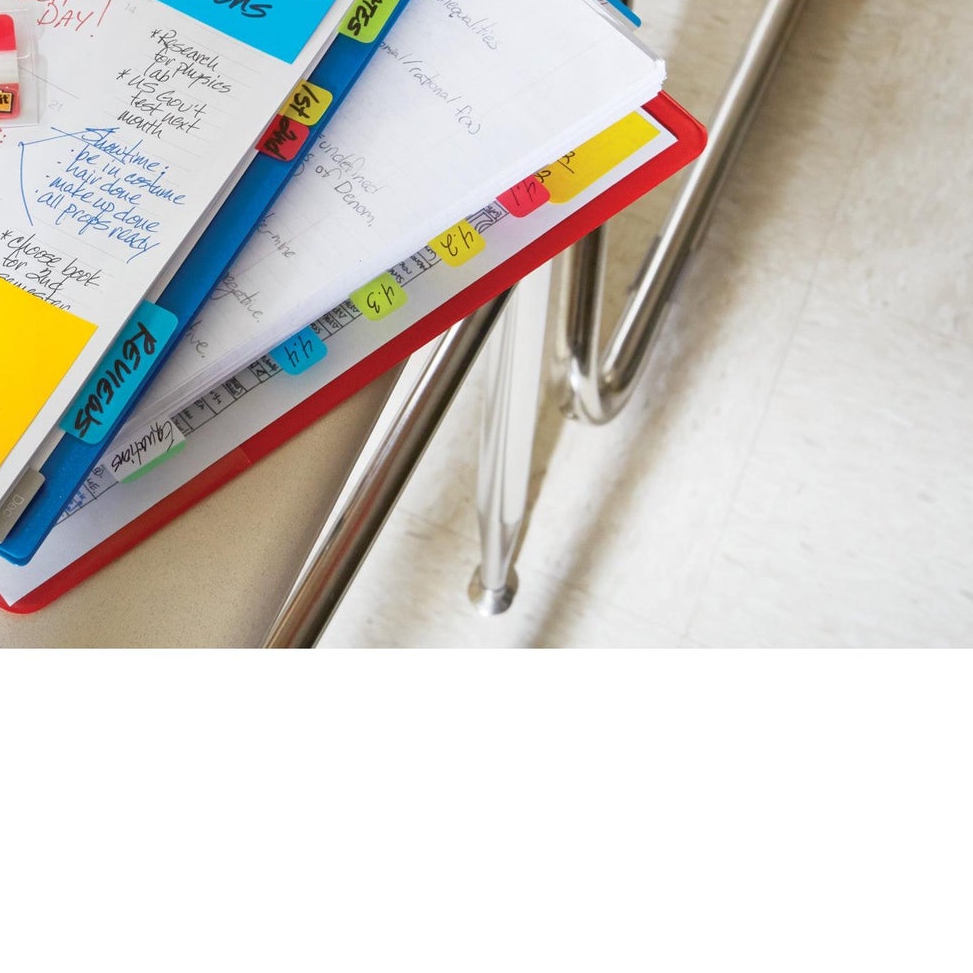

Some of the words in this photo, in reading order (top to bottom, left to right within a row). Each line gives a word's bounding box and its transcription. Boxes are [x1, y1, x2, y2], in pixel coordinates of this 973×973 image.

[143, 61, 170, 84] lab
[154, 48, 175, 66] for
[172, 60, 232, 94] physics
[127, 75, 159, 95] US
[155, 90, 207, 119] Gov't
[129, 90, 164, 117] test
[161, 111, 201, 134] next
[289, 84, 320, 119] 1st
[116, 109, 163, 139] month
[65, 159, 102, 186] hair
[100, 178, 142, 206] done
[76, 143, 97, 165] be
[102, 159, 120, 177] in
[124, 171, 187, 206] costume
[49, 176, 93, 203] make
[91, 197, 115, 220] up
[113, 205, 160, 233] done
[36, 191, 64, 209] all
[55, 203, 112, 236] props
[108, 224, 160, 264] ready
[440, 225, 474, 257] 4.2
[2, 250, 28, 271] for
[7, 233, 63, 269] choose
[61, 258, 102, 288] book
[367, 283, 395, 314] 4.3
[285, 335, 315, 368] 4.4
[73, 321, 159, 440] REVIEWS
[110, 418, 176, 474] Equations
[3, 494, 25, 517] Dec
